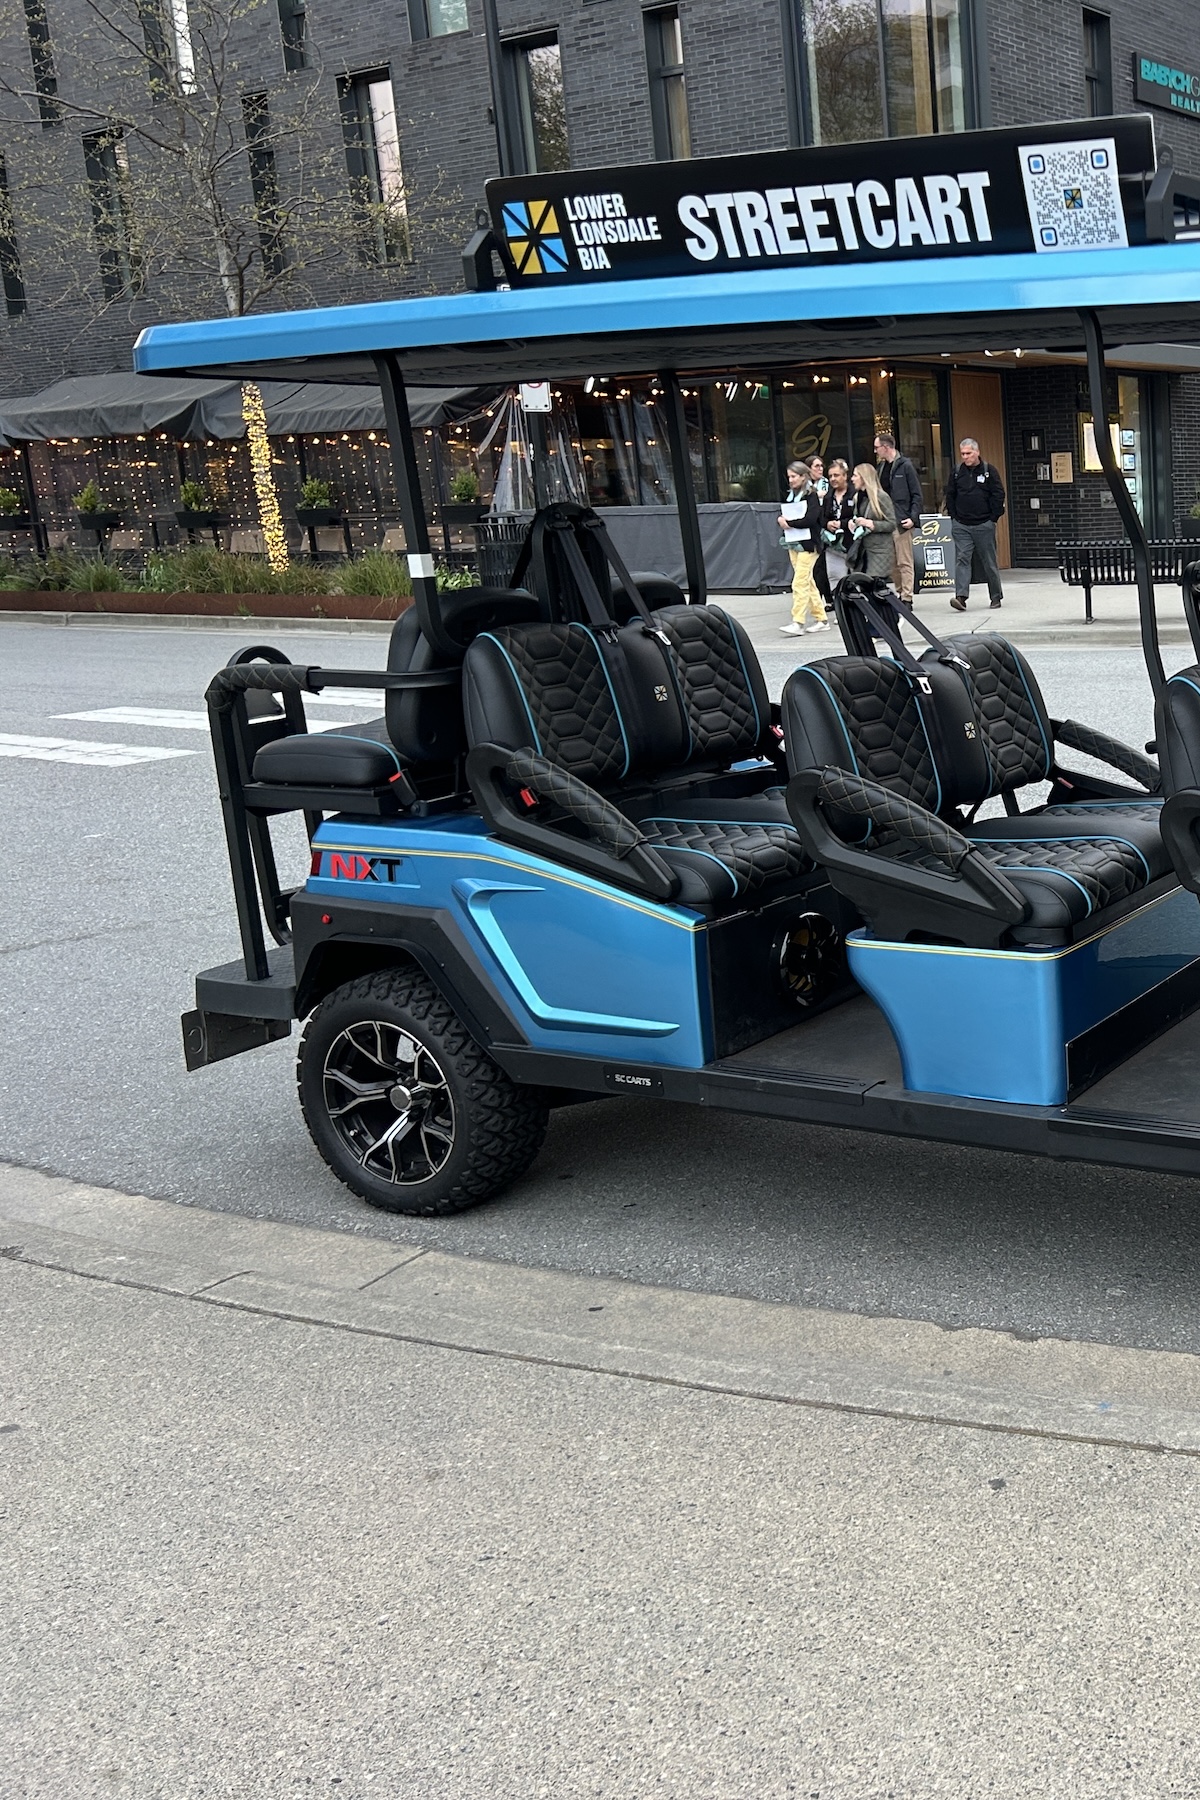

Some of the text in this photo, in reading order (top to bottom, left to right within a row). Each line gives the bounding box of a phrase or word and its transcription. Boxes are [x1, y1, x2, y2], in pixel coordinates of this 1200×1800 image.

[564, 193, 626, 221] LOWER
[677, 171, 993, 262] STREETCART
[571, 216, 662, 244] LONSDALE
[577, 246, 611, 271] BIA
[939, 570, 949, 578] US
[330, 853, 402, 882] NXT
[614, 1073, 652, 1086] SC CARTS
